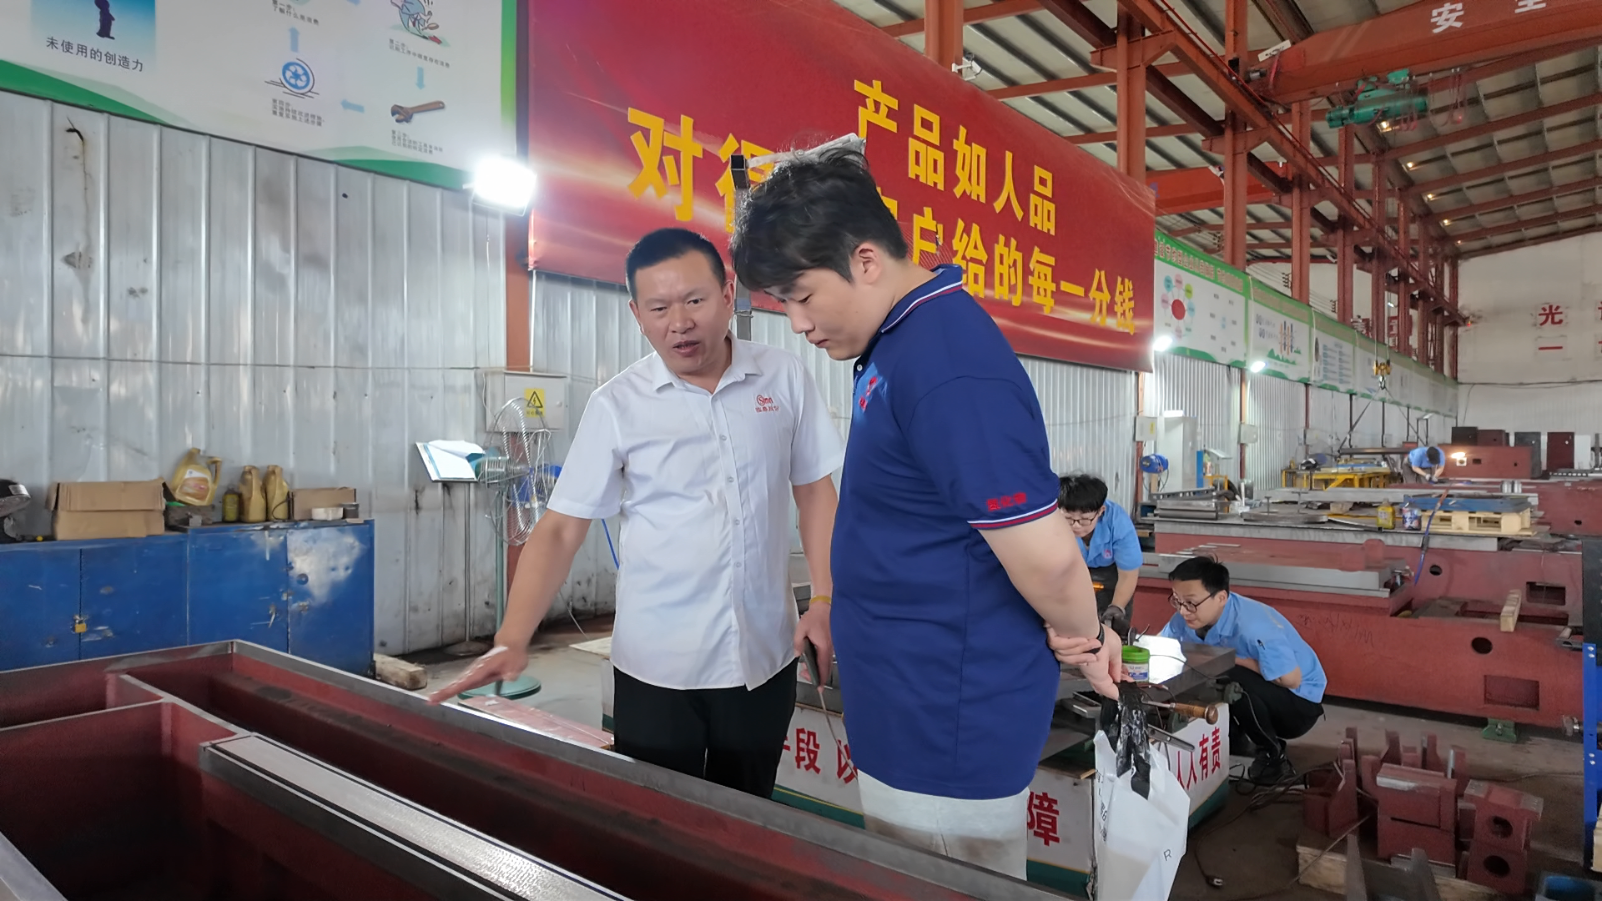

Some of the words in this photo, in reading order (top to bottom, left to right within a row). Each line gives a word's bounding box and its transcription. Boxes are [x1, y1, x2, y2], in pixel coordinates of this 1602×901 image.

[46, 36, 143, 72] 未使用的创造力
[854, 79, 1056, 236] 产品如人品
[628, 107, 1135, 335] 对户给的每一分钱
[1177, 727, 1221, 790] 人人有责
